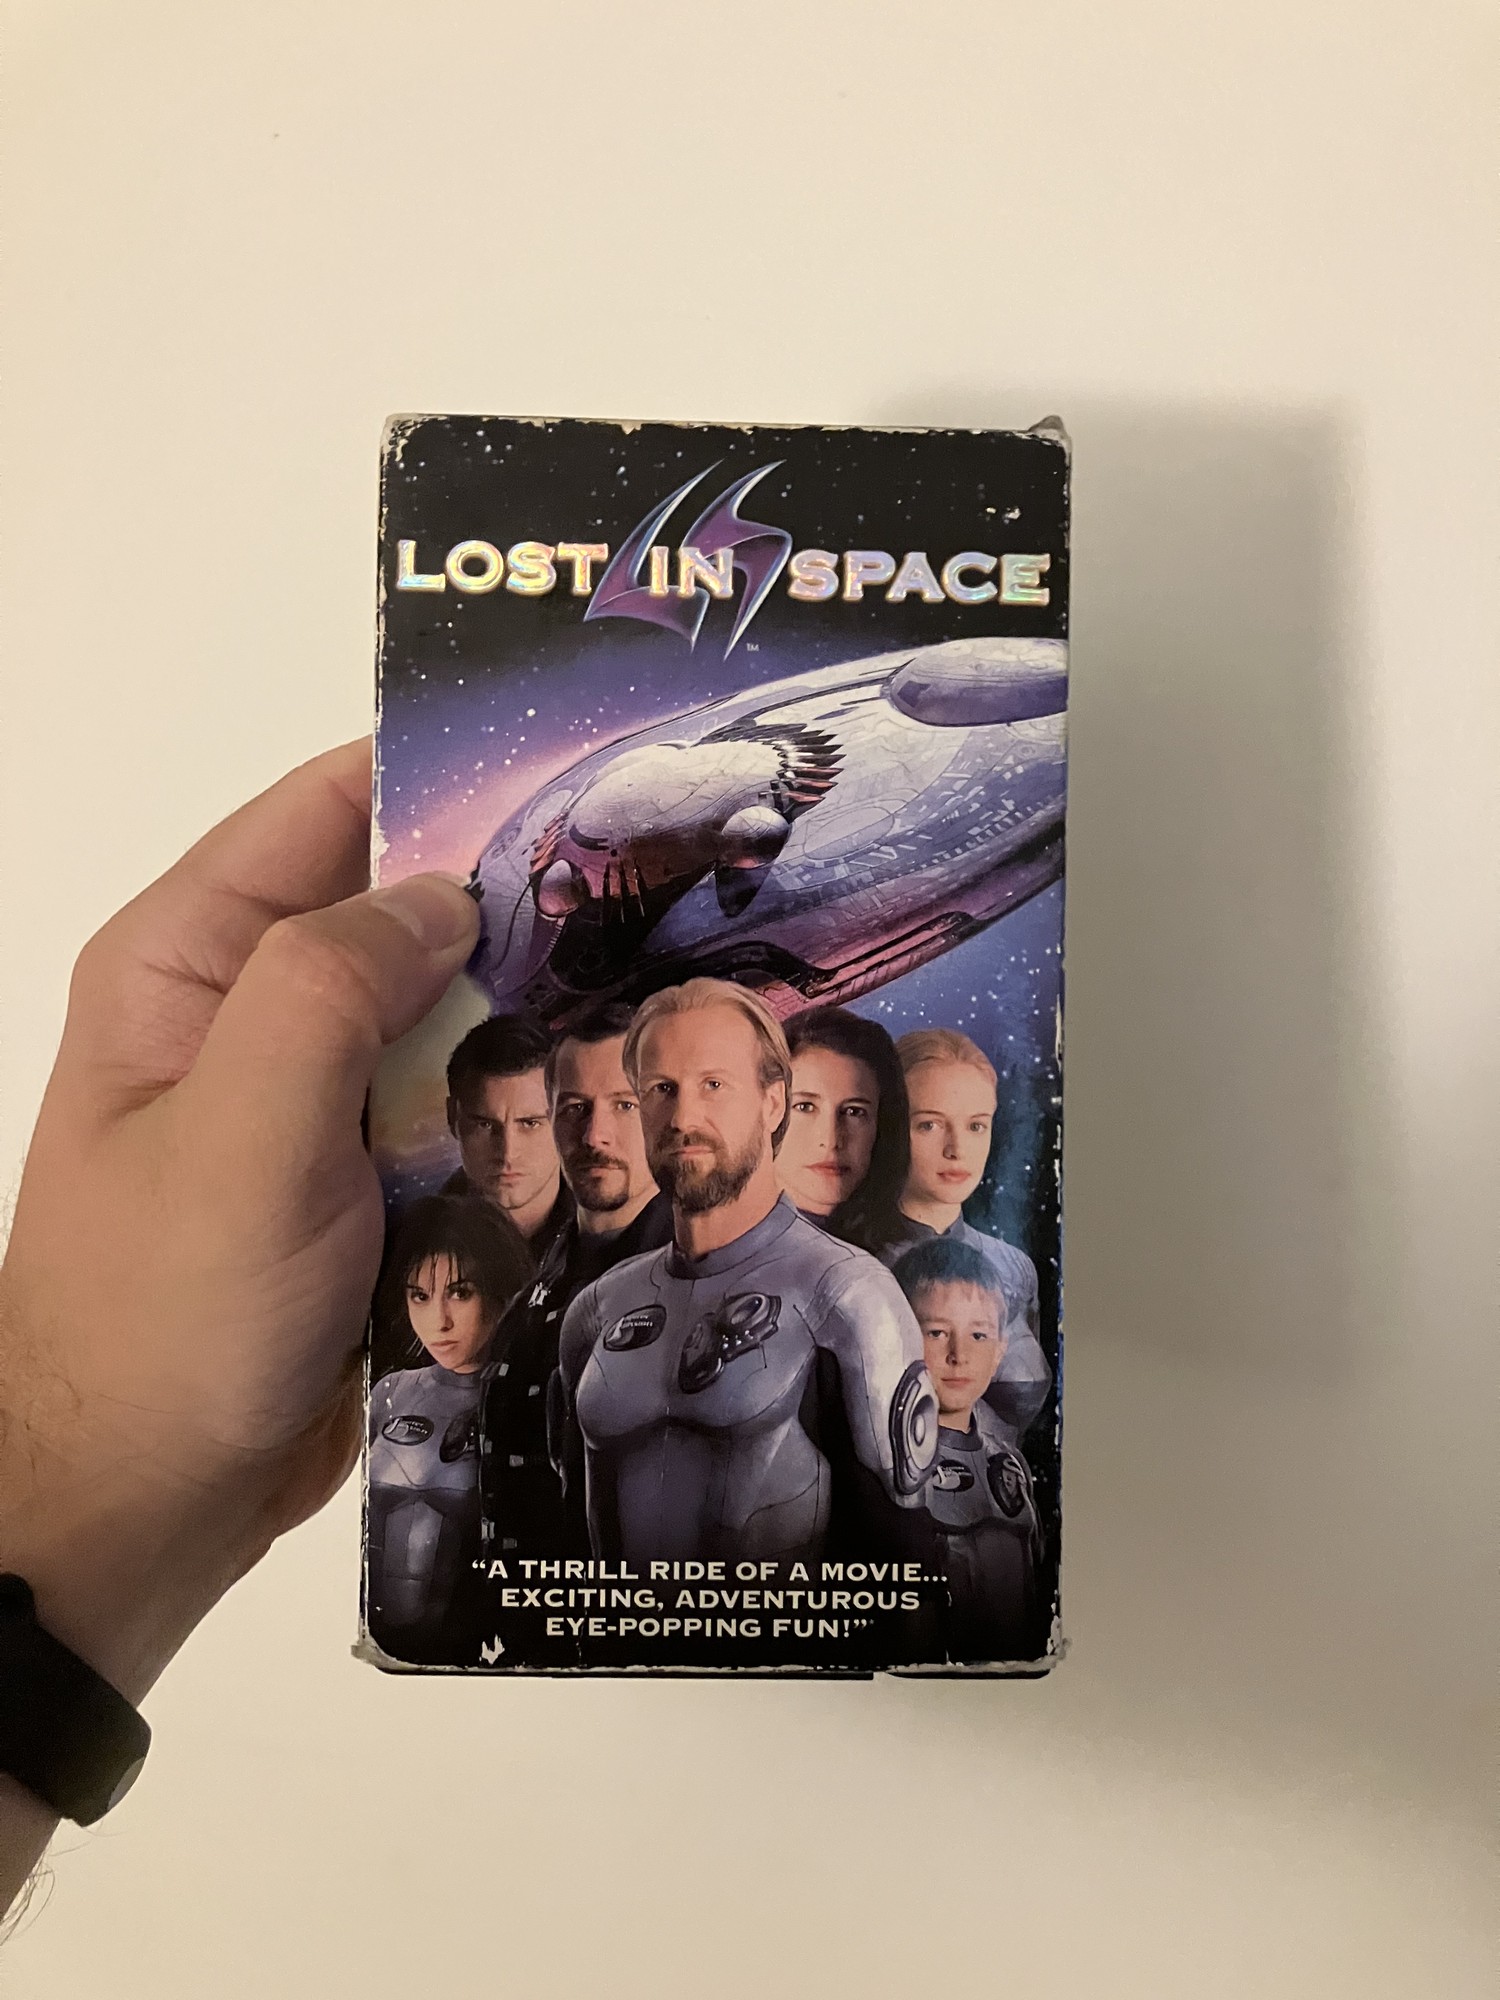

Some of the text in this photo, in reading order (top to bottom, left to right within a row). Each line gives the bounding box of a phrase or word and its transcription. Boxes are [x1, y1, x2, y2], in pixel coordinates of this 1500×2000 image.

[396, 539, 1052, 606] LOST IN SPACE
[518, 1560, 639, 1580] THRILL
[650, 1561, 725, 1581] RIDE
[735, 1562, 779, 1582] OF
[789, 1562, 810, 1582] A
[821, 1562, 948, 1583] MOVIE...
[501, 1588, 921, 1612] EXCITING, ADVENTUROUS
[546, 1617, 762, 1638] EYE-POPPING
